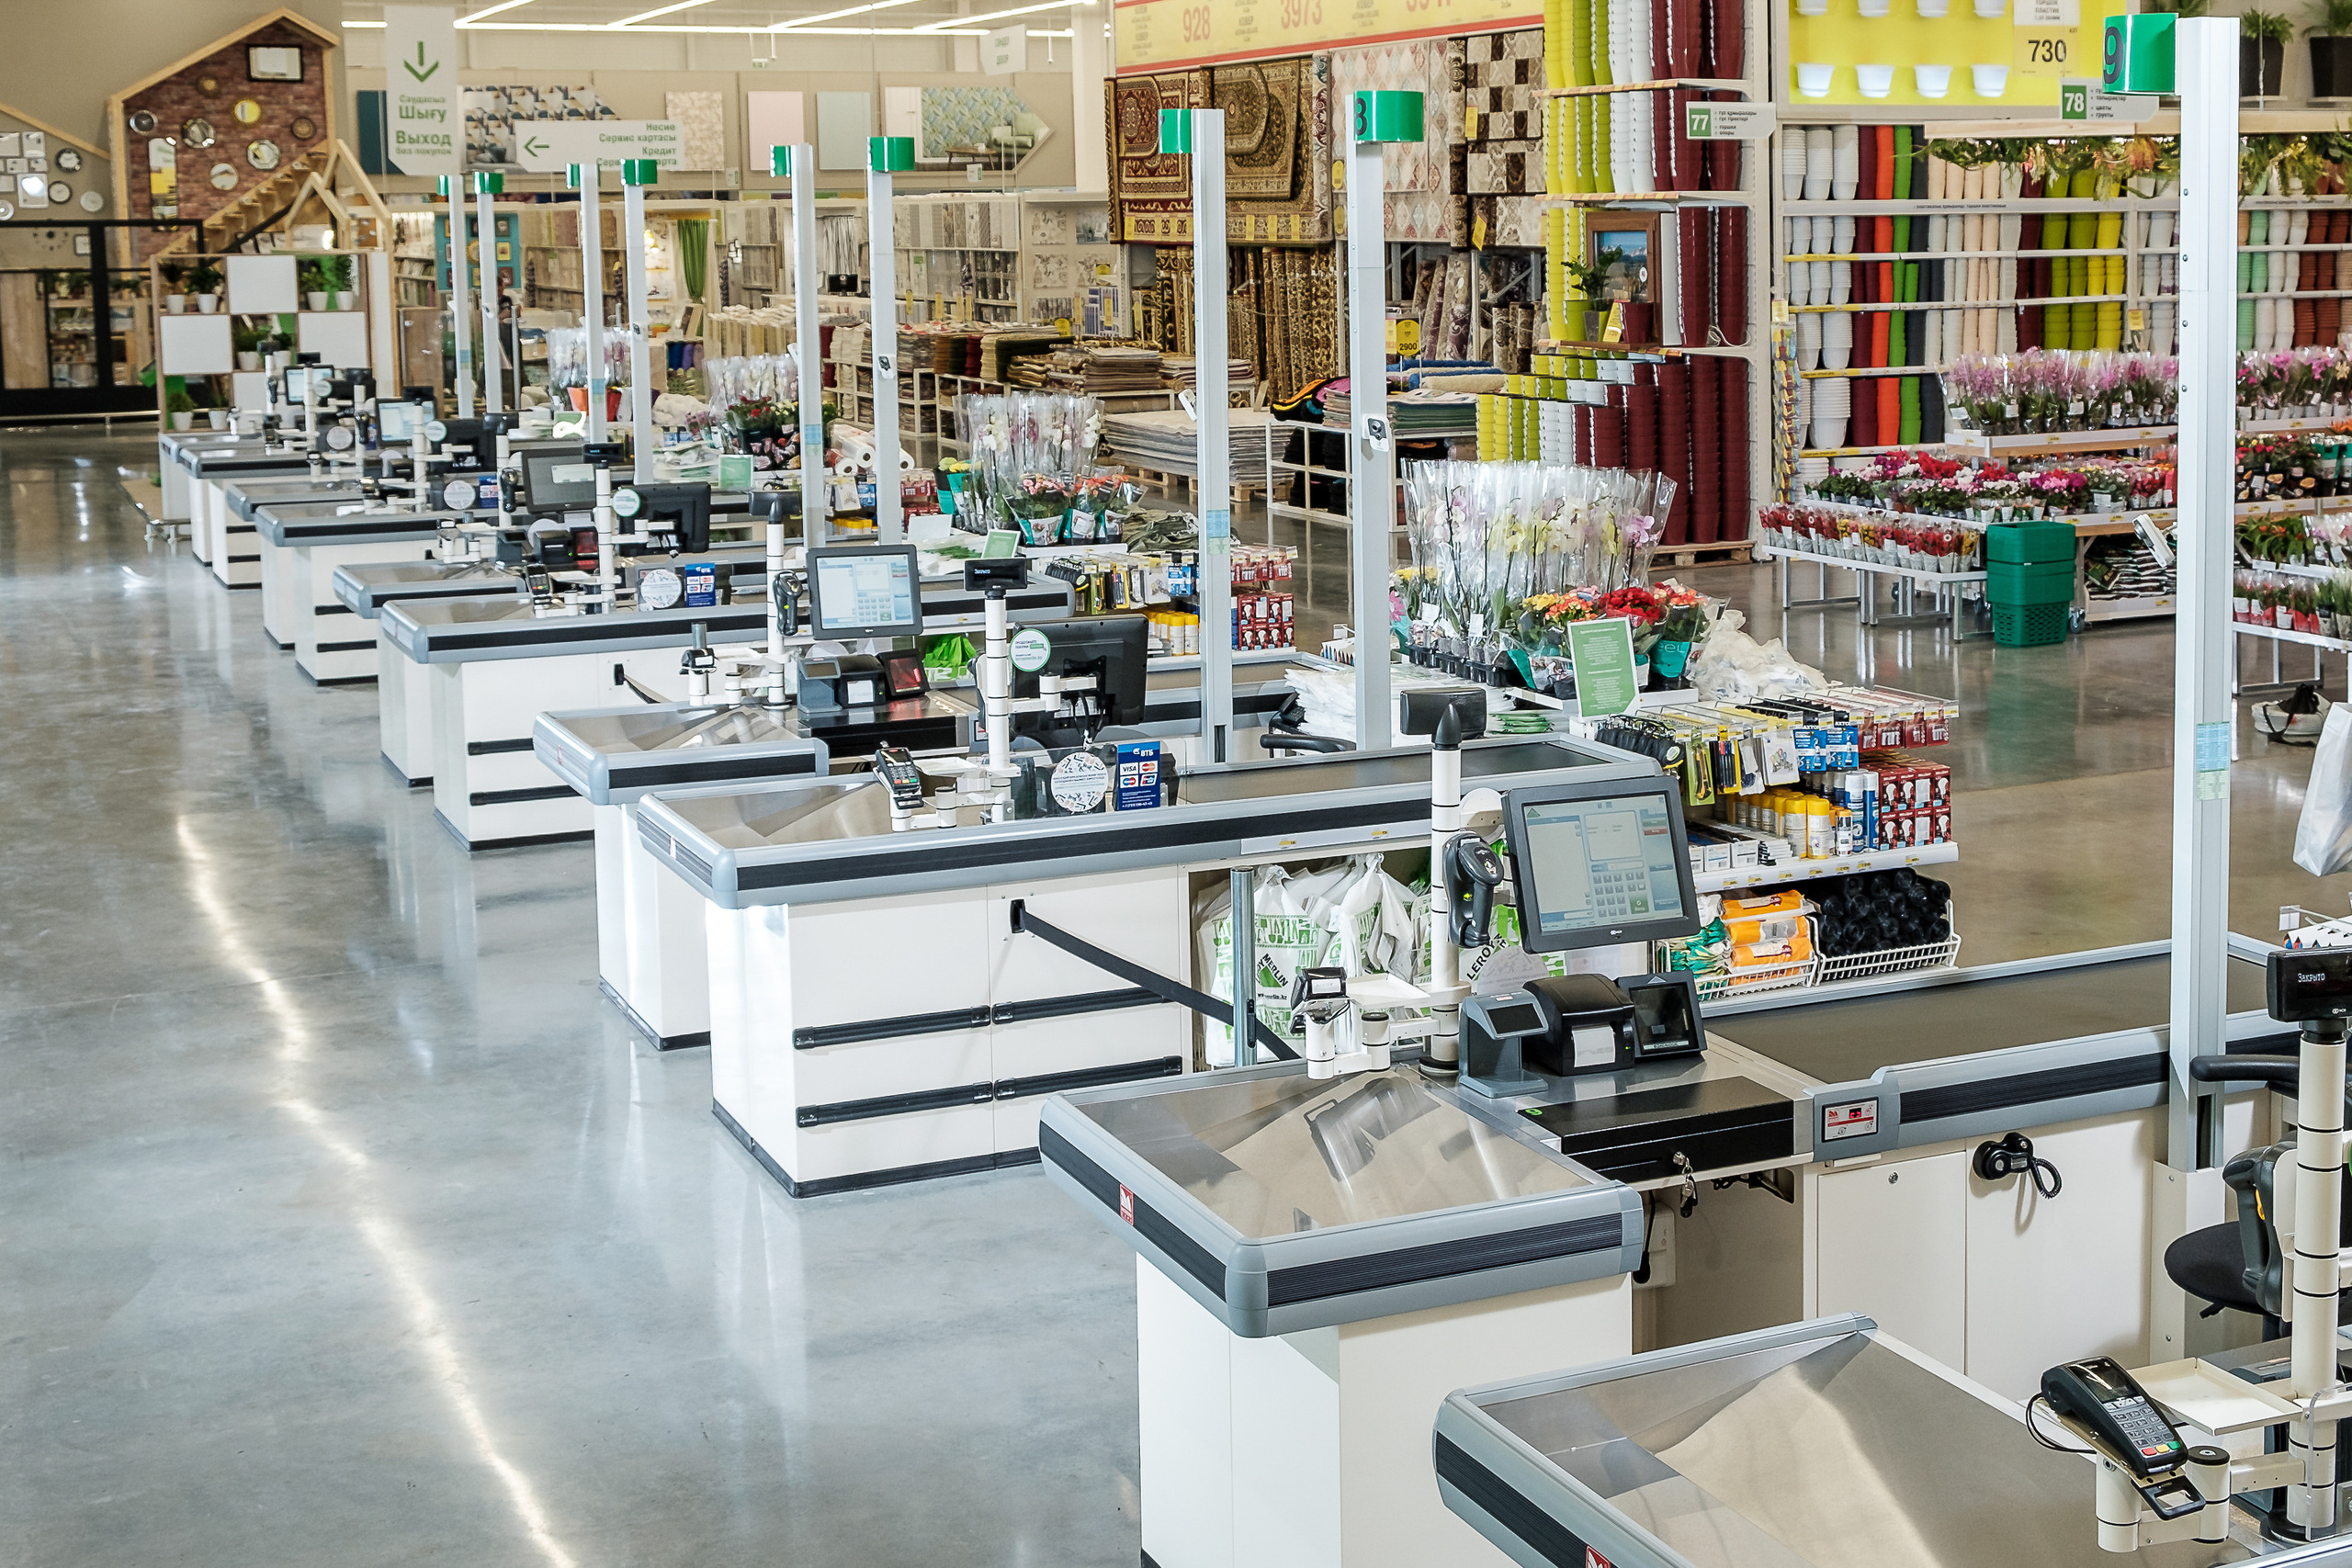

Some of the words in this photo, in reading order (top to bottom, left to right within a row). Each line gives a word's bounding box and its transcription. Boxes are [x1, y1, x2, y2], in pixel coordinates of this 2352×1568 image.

[1182, 5, 1212, 43] 928
[2028, 39, 2067, 62] 730
[2103, 26, 2123, 85] 9
[2064, 93, 2085, 112] 78
[399, 106, 447, 123] Шығу
[1354, 97, 1367, 136] 8
[1691, 114, 1709, 131] 77
[646, 123, 676, 131] Несие
[395, 130, 452, 147] Выход
[599, 134, 635, 143] Сервис
[396, 147, 413, 155] без
[414, 148, 451, 156] покупок
[642, 147, 677, 155] Кредит
[597, 158, 620, 167] Серв
[656, 159, 677, 167] арта
[1140, 749, 1154, 757] ВТБ
[1466, 940, 1495, 981] LEROY
[1262, 953, 1289, 987] MERLIN
[2297, 973, 2325, 983] Закрыто
